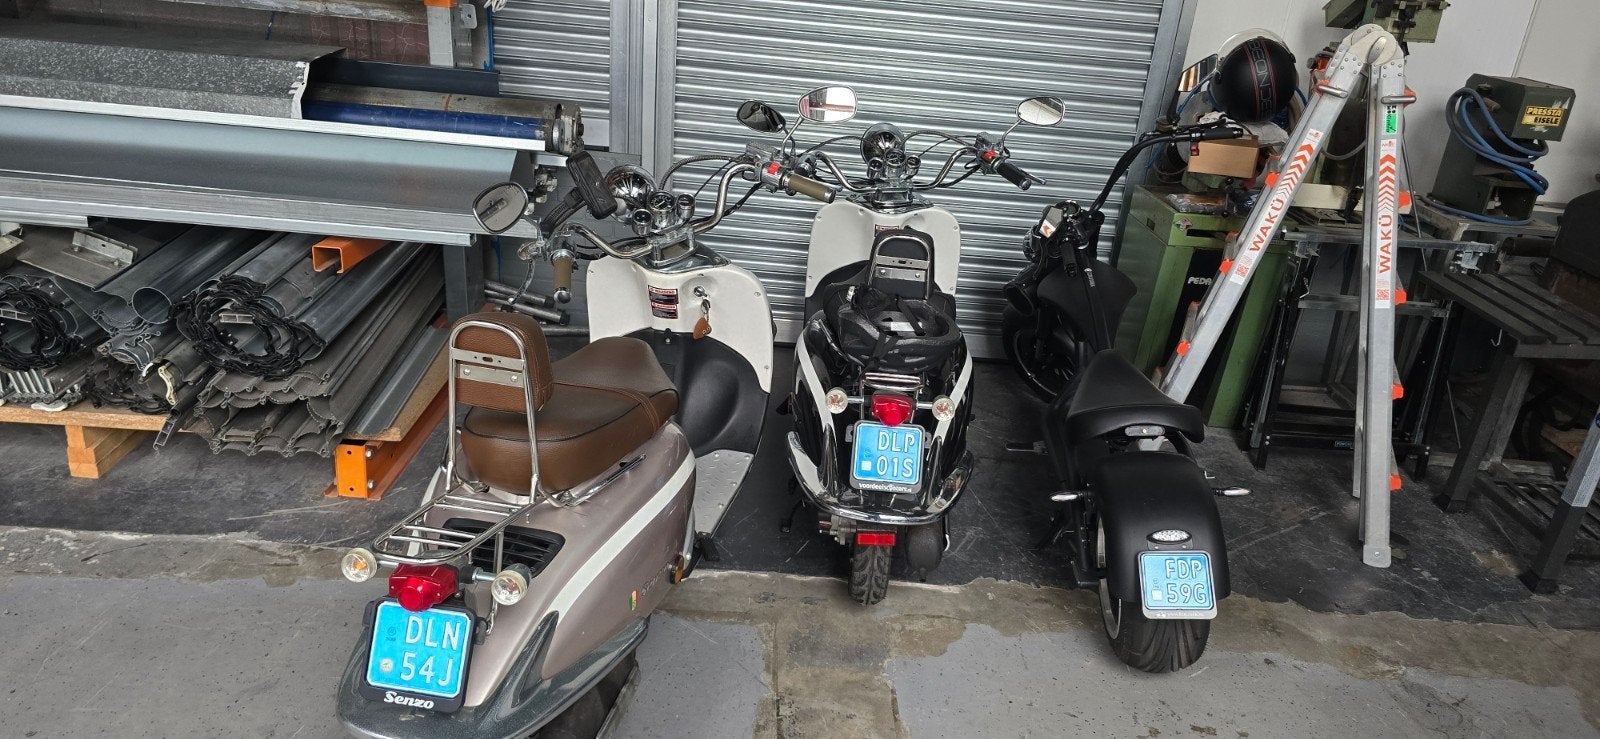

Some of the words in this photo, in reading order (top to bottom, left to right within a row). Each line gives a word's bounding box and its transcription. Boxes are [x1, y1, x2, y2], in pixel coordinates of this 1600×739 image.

[1534, 116, 1559, 124] EISELE
[1248, 198, 1285, 252] WAKÜ
[1379, 214, 1392, 274] WAKÜ
[878, 431, 915, 453] DLP
[877, 456, 913, 478] 01S
[1165, 558, 1202, 579] FDP
[1167, 583, 1207, 604] 59G
[405, 615, 461, 651] DLN
[400, 652, 453, 687] 54J
[384, 691, 434, 709] Senzo
